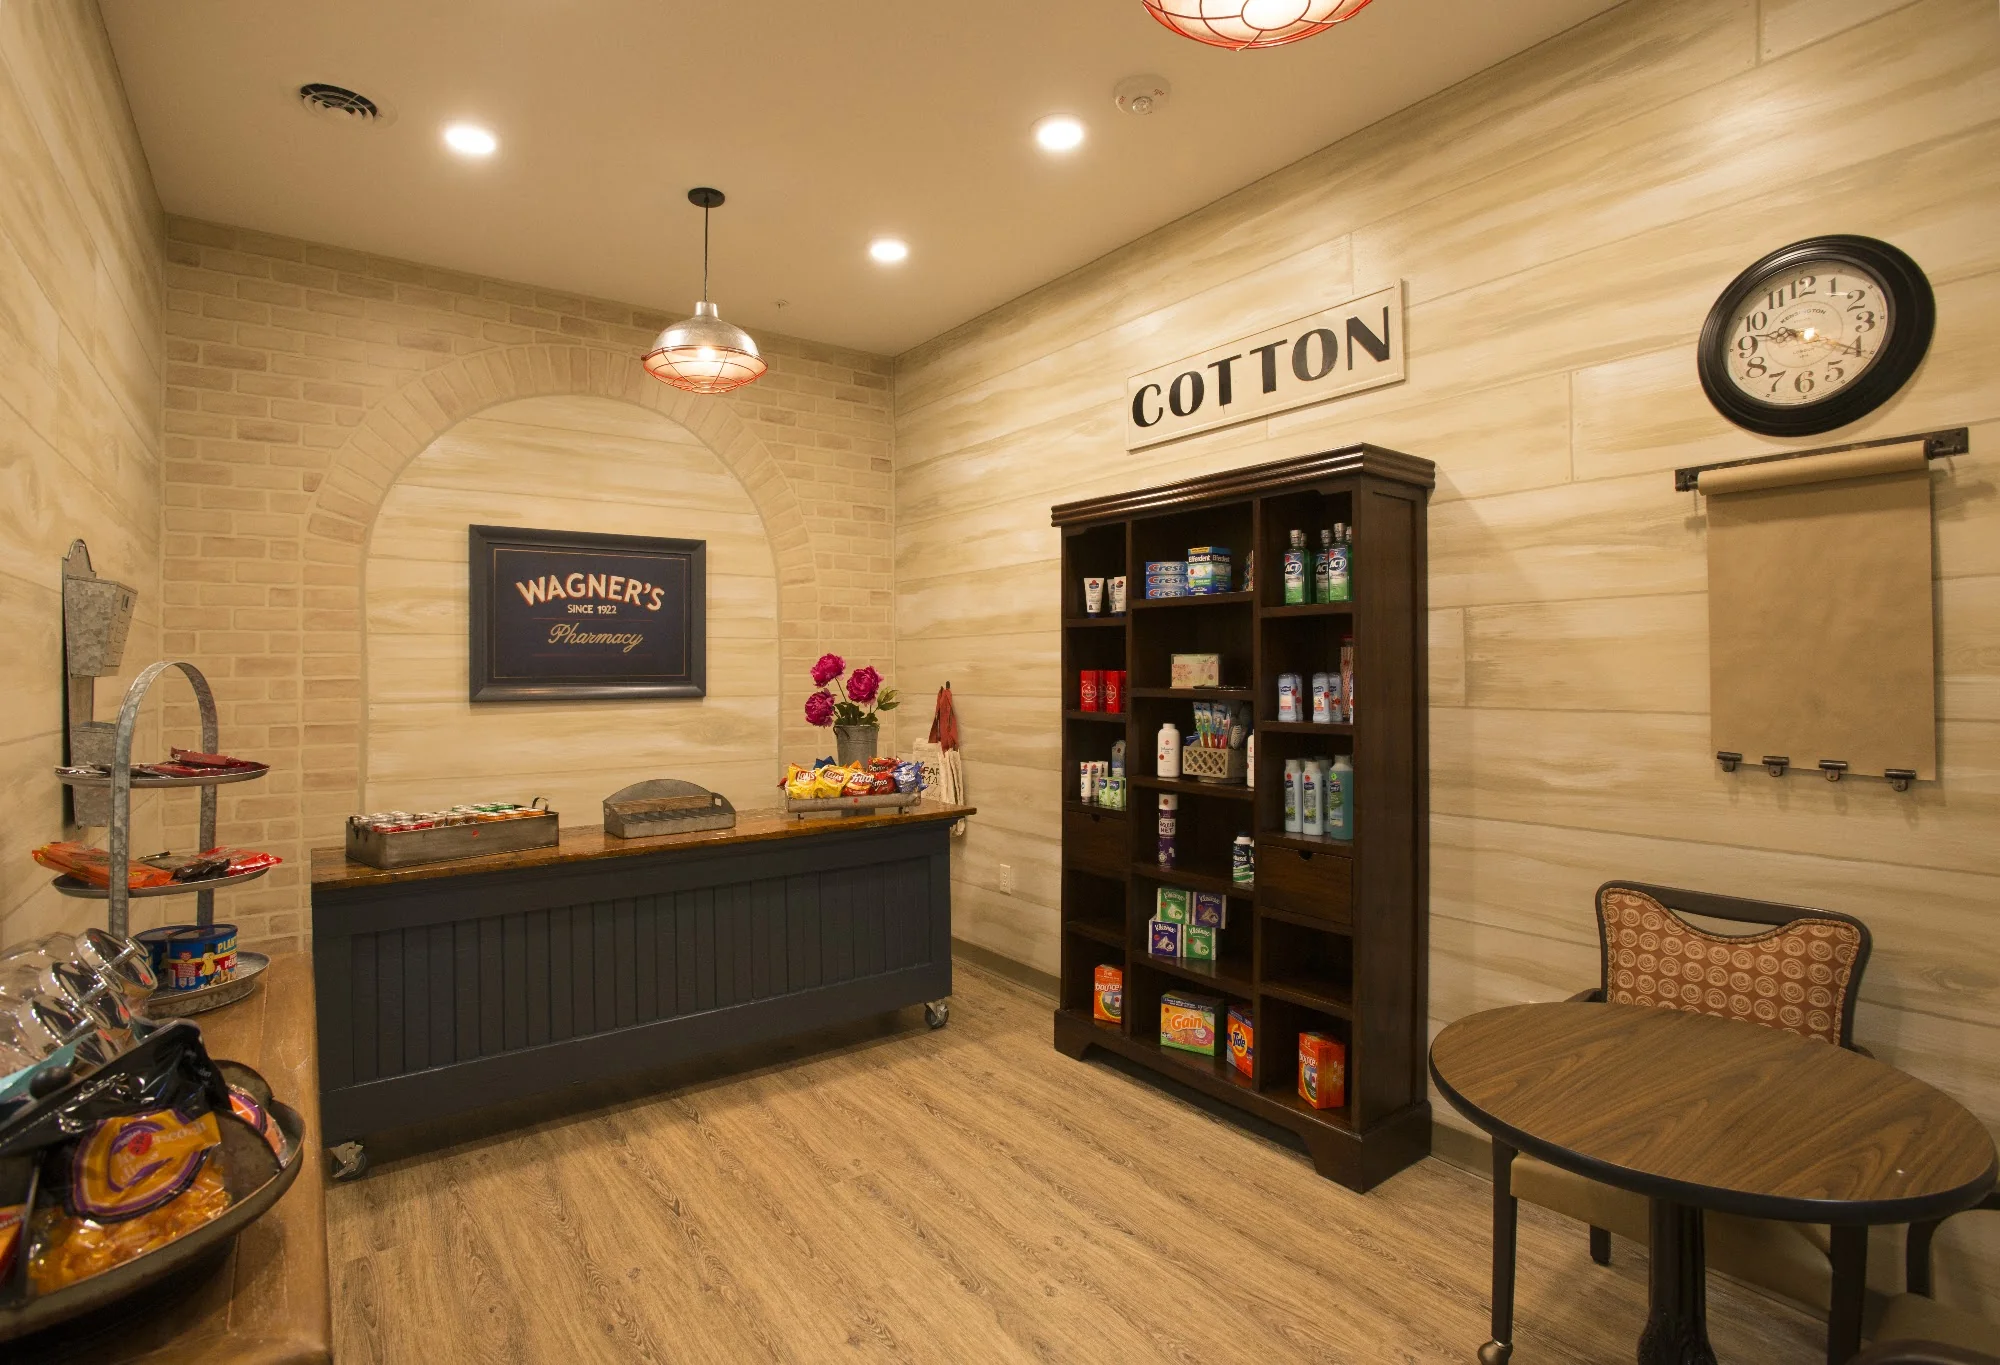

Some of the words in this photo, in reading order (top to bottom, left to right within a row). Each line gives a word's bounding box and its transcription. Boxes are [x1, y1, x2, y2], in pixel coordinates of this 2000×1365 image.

[1789, 276, 1817, 300] 12
[1828, 277, 1837, 298] 1
[1768, 288, 1785, 310] 11
[1846, 290, 1866, 312] 2
[1745, 311, 1768, 333] 10
[1855, 311, 1875, 333] 3
[1737, 336, 1759, 359] 9
[1842, 336, 1863, 358] 4
[1132, 306, 1391, 428] COTTON
[1745, 356, 1767, 379] 8
[1824, 360, 1844, 382] 5
[1768, 370, 1787, 393] 7
[1794, 370, 1815, 393] 6
[1147, 563, 1184, 572] Crest
[1147, 575, 1184, 584] Crest
[516, 572, 665, 611] WAGNER'S
[1148, 588, 1184, 597] Crest
[567, 604, 594, 614] SINCE
[597, 605, 617, 615] 1922
[548, 622, 644, 653] Pharmacy
[850, 772, 874, 783] Fritos
[1171, 1013, 1203, 1031] Gain
[1232, 1031, 1246, 1048] Tide
